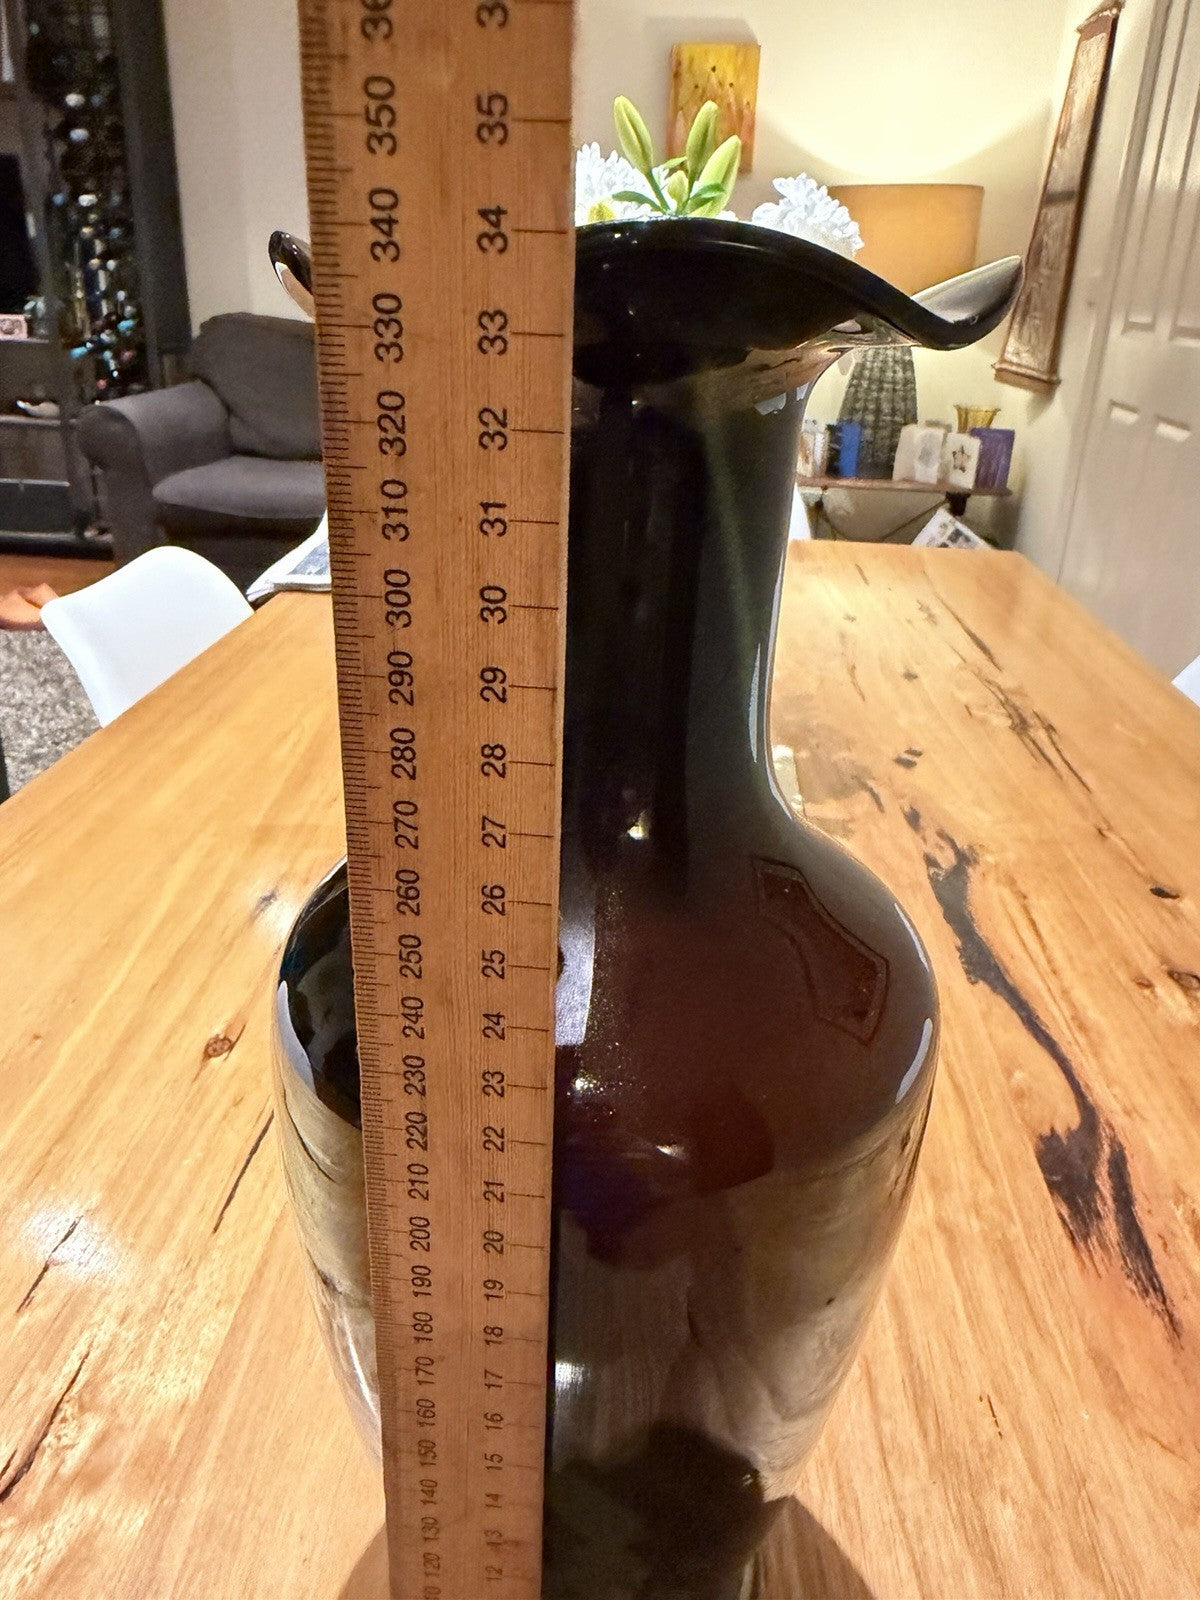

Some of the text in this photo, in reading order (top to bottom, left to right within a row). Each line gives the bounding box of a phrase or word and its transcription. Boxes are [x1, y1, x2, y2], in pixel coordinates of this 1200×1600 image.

[362, 75, 398, 157] 350
[475, 92, 509, 147] 35
[367, 187, 401, 264] 340
[475, 204, 509, 256] 34
[371, 292, 405, 364] 330
[476, 308, 510, 357] 33
[376, 389, 407, 458] 320
[477, 406, 509, 452] 32
[379, 478, 411, 543] 310
[476, 501, 508, 538] 31
[382, 568, 413, 629] 300
[477, 582, 508, 626] 30
[386, 649, 415, 707] 290
[477, 665, 508, 705] 29
[389, 727, 417, 781] 280
[480, 742, 508, 780] 28
[392, 800, 420, 851] 270
[480, 814, 507, 850] 27
[394, 868, 421, 917] 260
[480, 884, 507, 917] 26
[397, 933, 423, 980] 250
[480, 948, 506, 980] 25
[400, 995, 425, 1040] 240
[481, 1011, 506, 1042] 24
[402, 1054, 427, 1098] 230
[481, 1068, 506, 1099] 23
[404, 1109, 428, 1152] 220
[481, 1125, 505, 1154] 22
[406, 1162, 430, 1202] 210
[482, 1179, 505, 1204] 21
[408, 1215, 431, 1253] 200
[482, 1228, 505, 1256] 20
[410, 1264, 433, 1298] 190
[482, 1278, 505, 1302] 19
[411, 1311, 434, 1344] 180
[482, 1324, 504, 1346] 18
[413, 1356, 435, 1386] 170
[483, 1368, 503, 1390] 17
[415, 1398, 437, 1428] 160
[483, 1412, 504, 1431] 16
[417, 1439, 438, 1467] 150
[483, 1452, 504, 1471] 15
[418, 1478, 439, 1506] 140
[484, 1493, 503, 1509] 14
[420, 1516, 441, 1543] 130
[483, 1529, 503, 1549] 13
[422, 1552, 441, 1578] 120
[484, 1565, 503, 1582] 12
